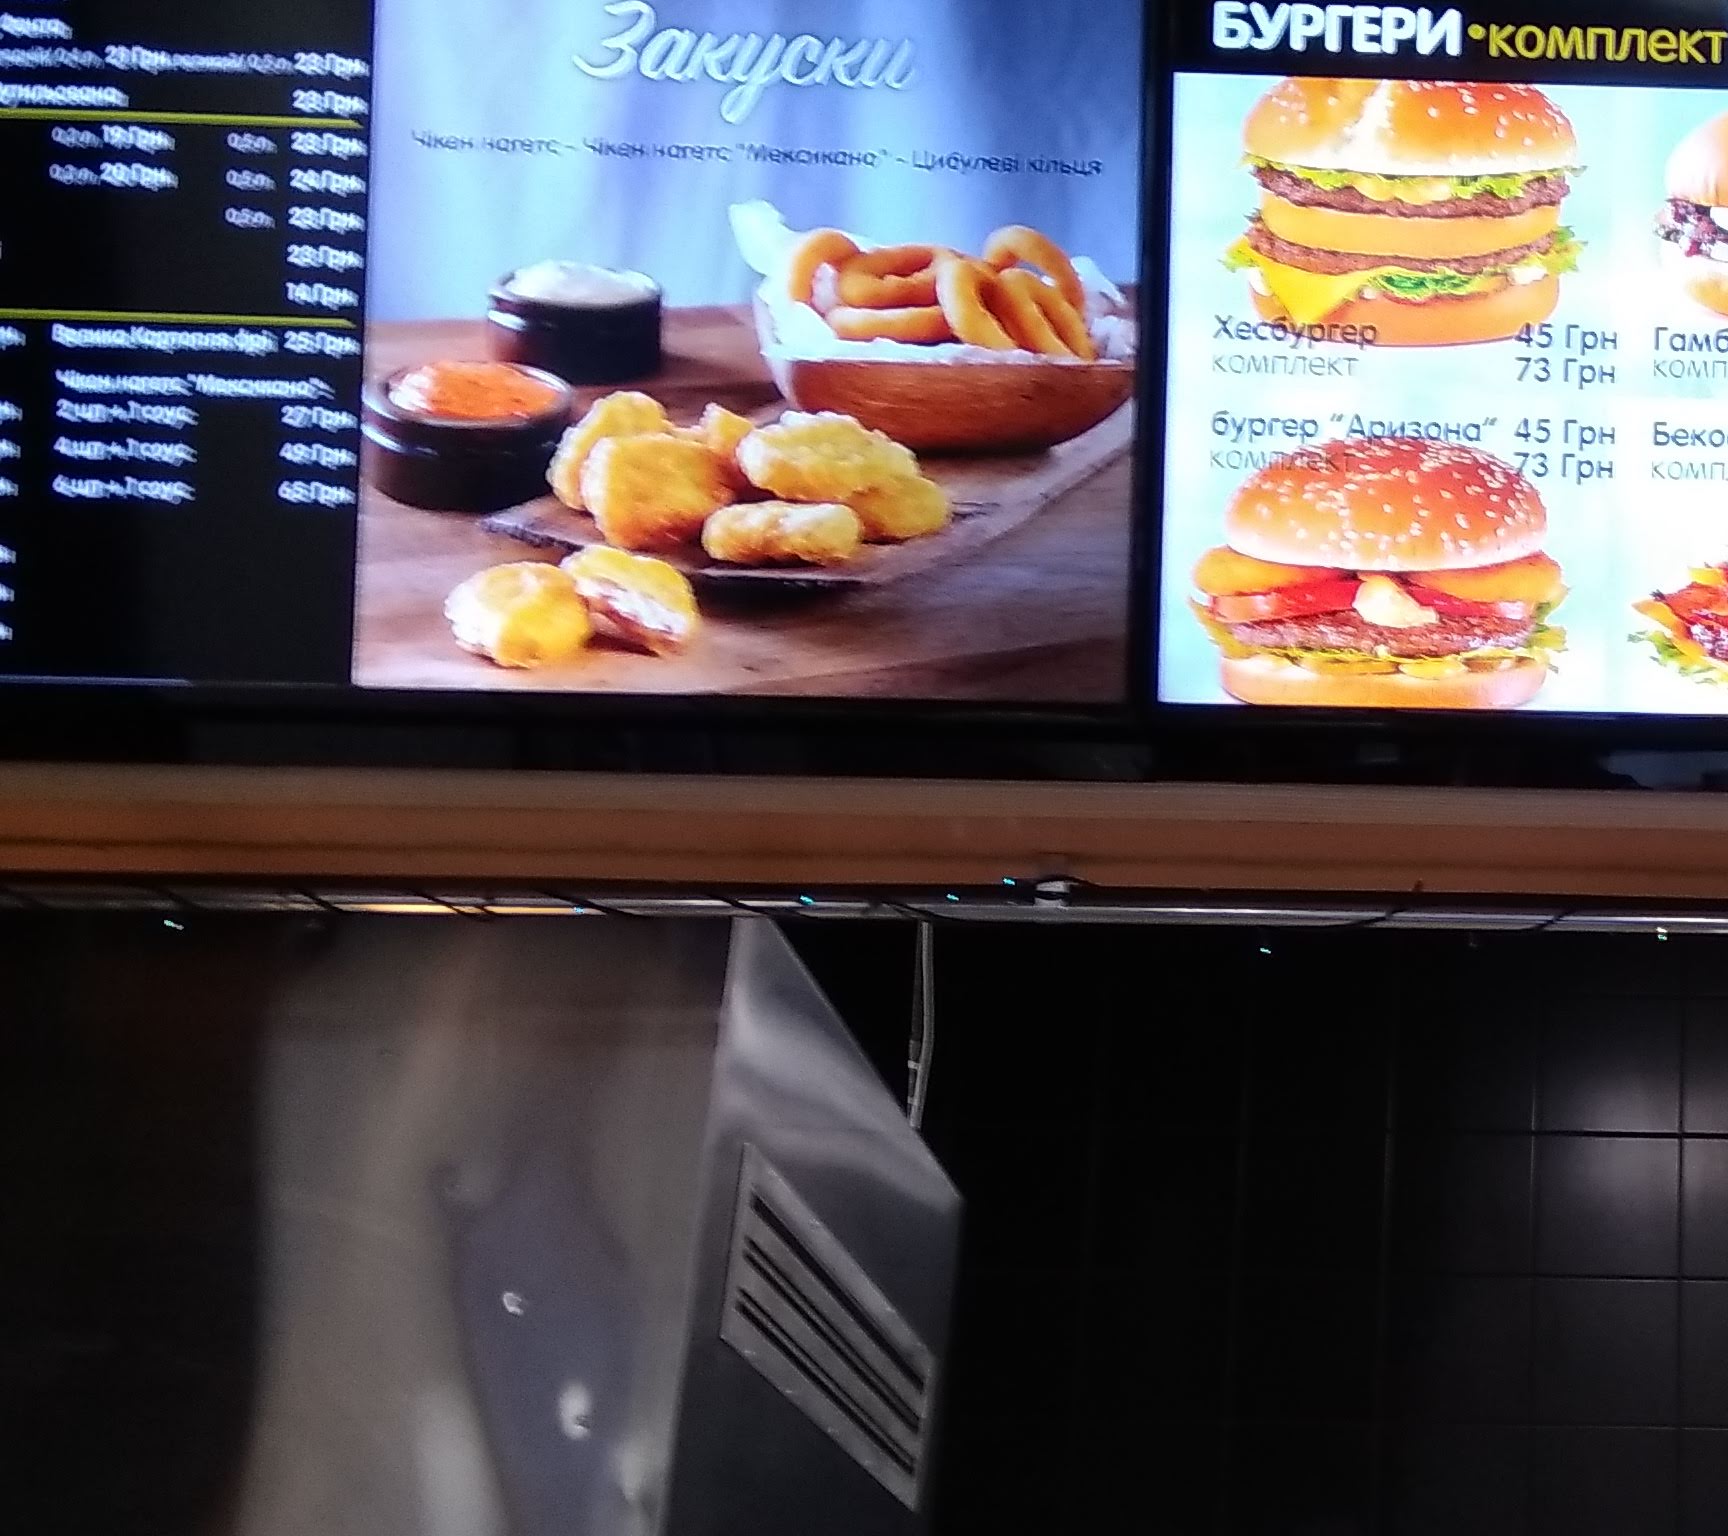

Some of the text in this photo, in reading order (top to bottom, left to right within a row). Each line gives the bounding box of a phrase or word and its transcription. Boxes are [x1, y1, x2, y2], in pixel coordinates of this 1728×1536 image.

[1212, 0, 1462, 55] БУРГЕРИ
[572, 0, 915, 125] Закуски
[1213, 314, 1618, 355] Хесбургер 45 Грн
[1211, 354, 1616, 389] комплект 73 Грн
[1211, 410, 1319, 445] бургер
[1513, 418, 1551, 444] 45
[1563, 419, 1616, 451] Грн
[1209, 450, 1614, 483] комплект 73 Грн
